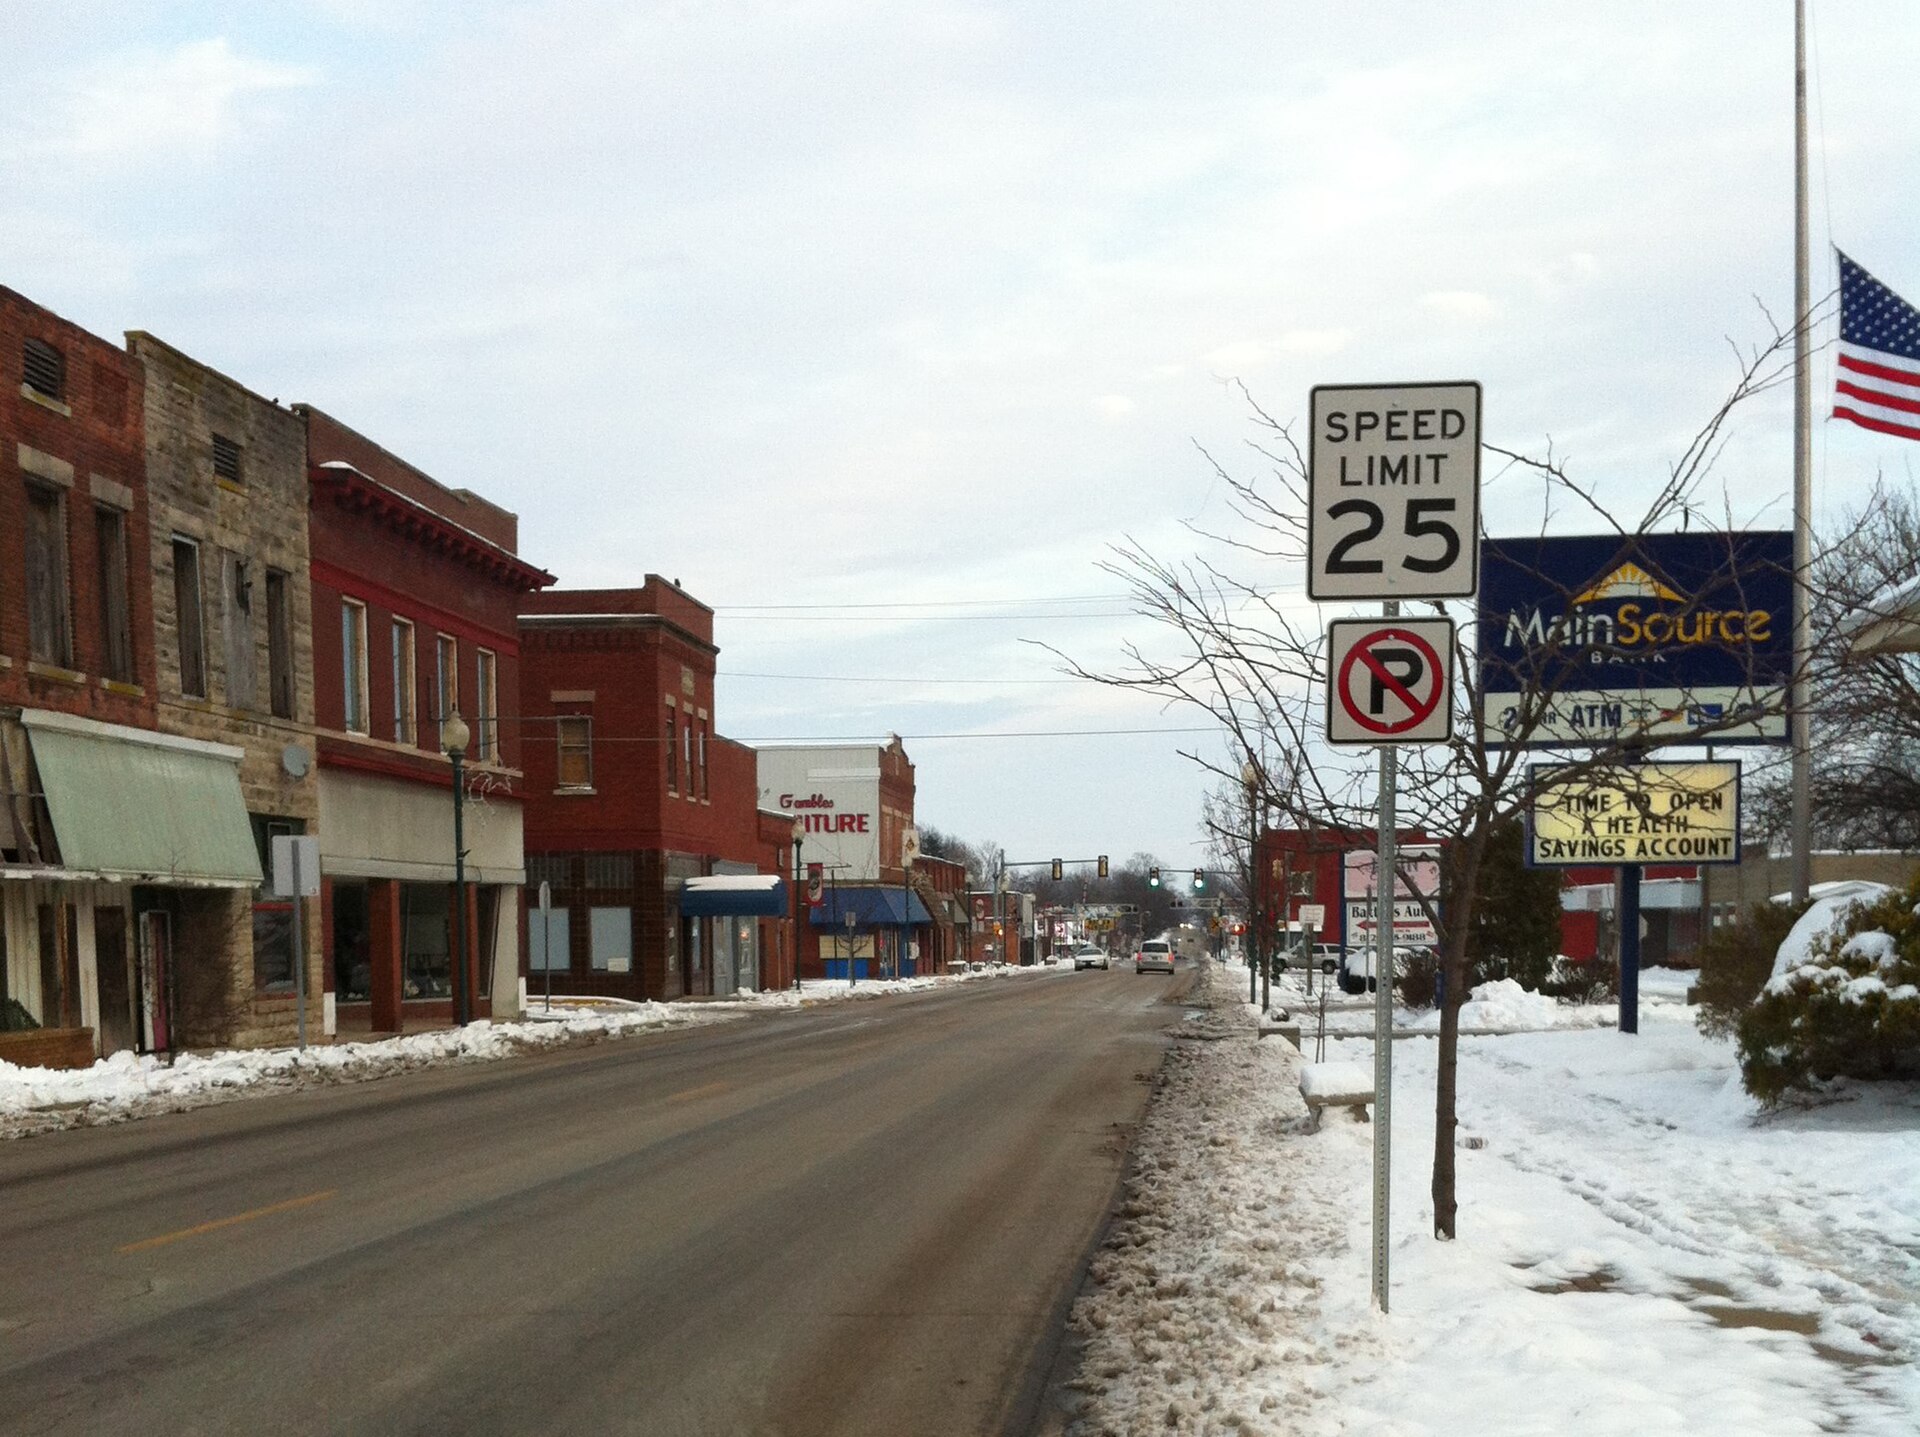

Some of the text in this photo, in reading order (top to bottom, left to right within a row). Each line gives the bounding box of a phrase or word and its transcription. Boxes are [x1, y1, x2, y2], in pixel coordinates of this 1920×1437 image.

[1325, 409, 1466, 443] SPEED
[1340, 454, 1448, 487] LIMIT
[1325, 498, 1461, 574] 25
[1504, 603, 1771, 648] MainSource
[1591, 649, 1667, 664] BAK
[1570, 704, 1622, 728] ATM
[1564, 793, 1610, 814] TIME
[1670, 792, 1723, 811] OPEN
[1608, 815, 1688, 834] HEALTH
[1540, 837, 1732, 858] SAVINGS ACCOUNT
